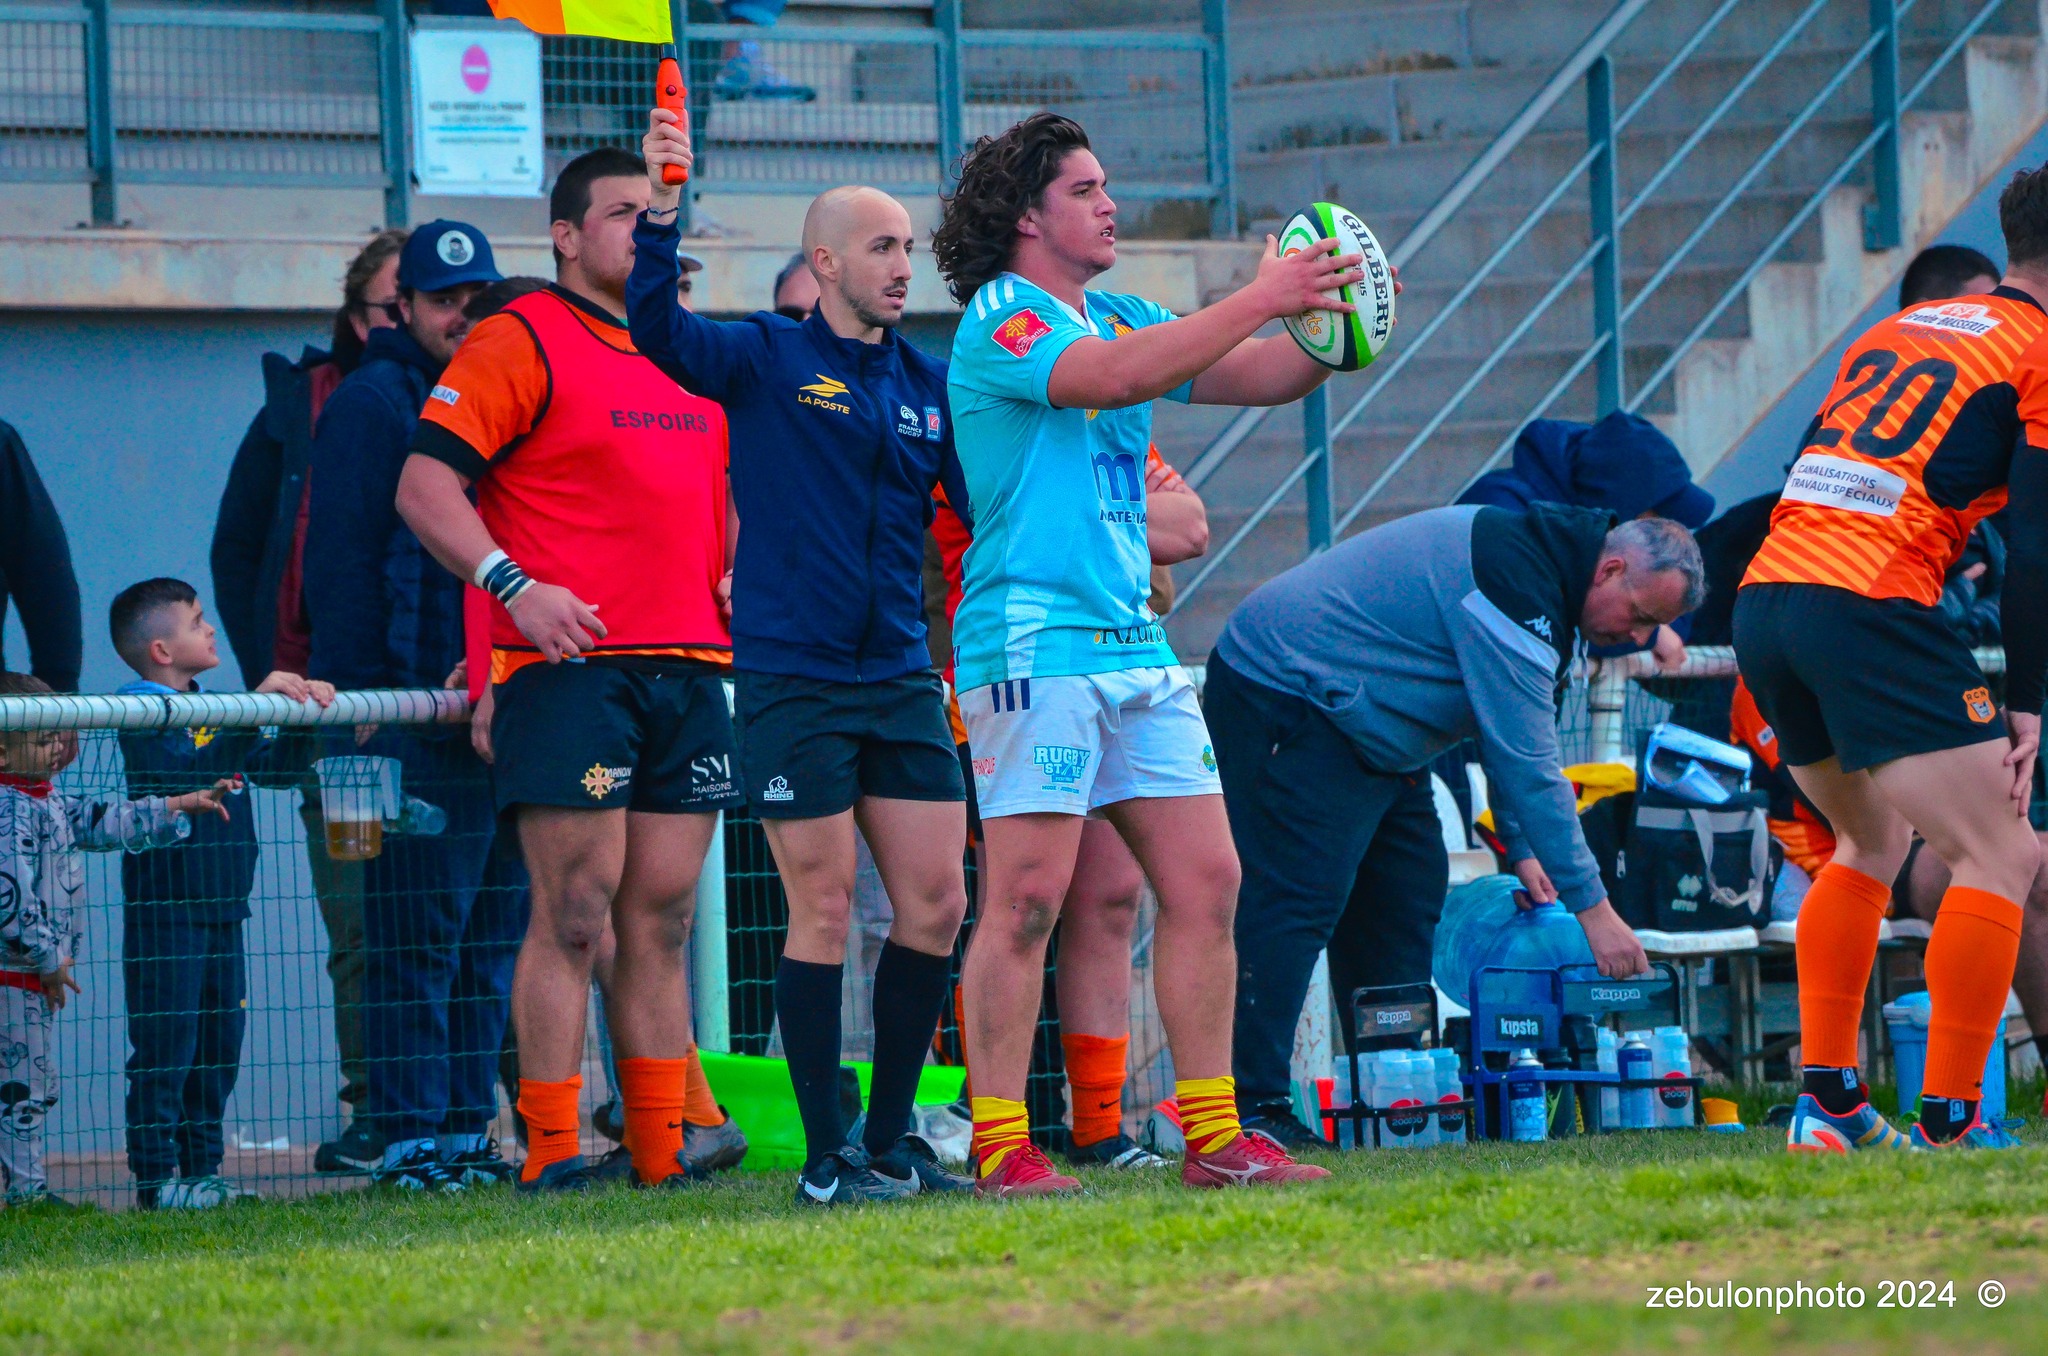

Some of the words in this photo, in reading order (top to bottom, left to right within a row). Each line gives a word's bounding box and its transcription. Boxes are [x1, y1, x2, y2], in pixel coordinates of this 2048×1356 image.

[1342, 214, 1390, 342] GILBERT
[797, 394, 812, 404] LA
[813, 398, 850, 415] POSTE
[1807, 349, 1957, 459] 20
[610, 410, 709, 434] ESPOIRS
[898, 423, 922, 434] FRANCE
[897, 428, 922, 438] RUGBY
[1797, 464, 1877, 489] CANALISATIONS
[1791, 478, 1832, 493] TRAVAUX
[1832, 484, 1896, 510] SPECIAUX
[1035, 747, 1090, 767] RUGBY
[691, 754, 731, 783] SM
[692, 781, 732, 795] MAISONS
[764, 791, 794, 800] RHINO
[1591, 988, 1641, 1001] Kappa
[1377, 1010, 1411, 1024] Kappa
[1500, 1018, 1539, 1037] kipsta
[1664, 1090, 1687, 1099] 2000
